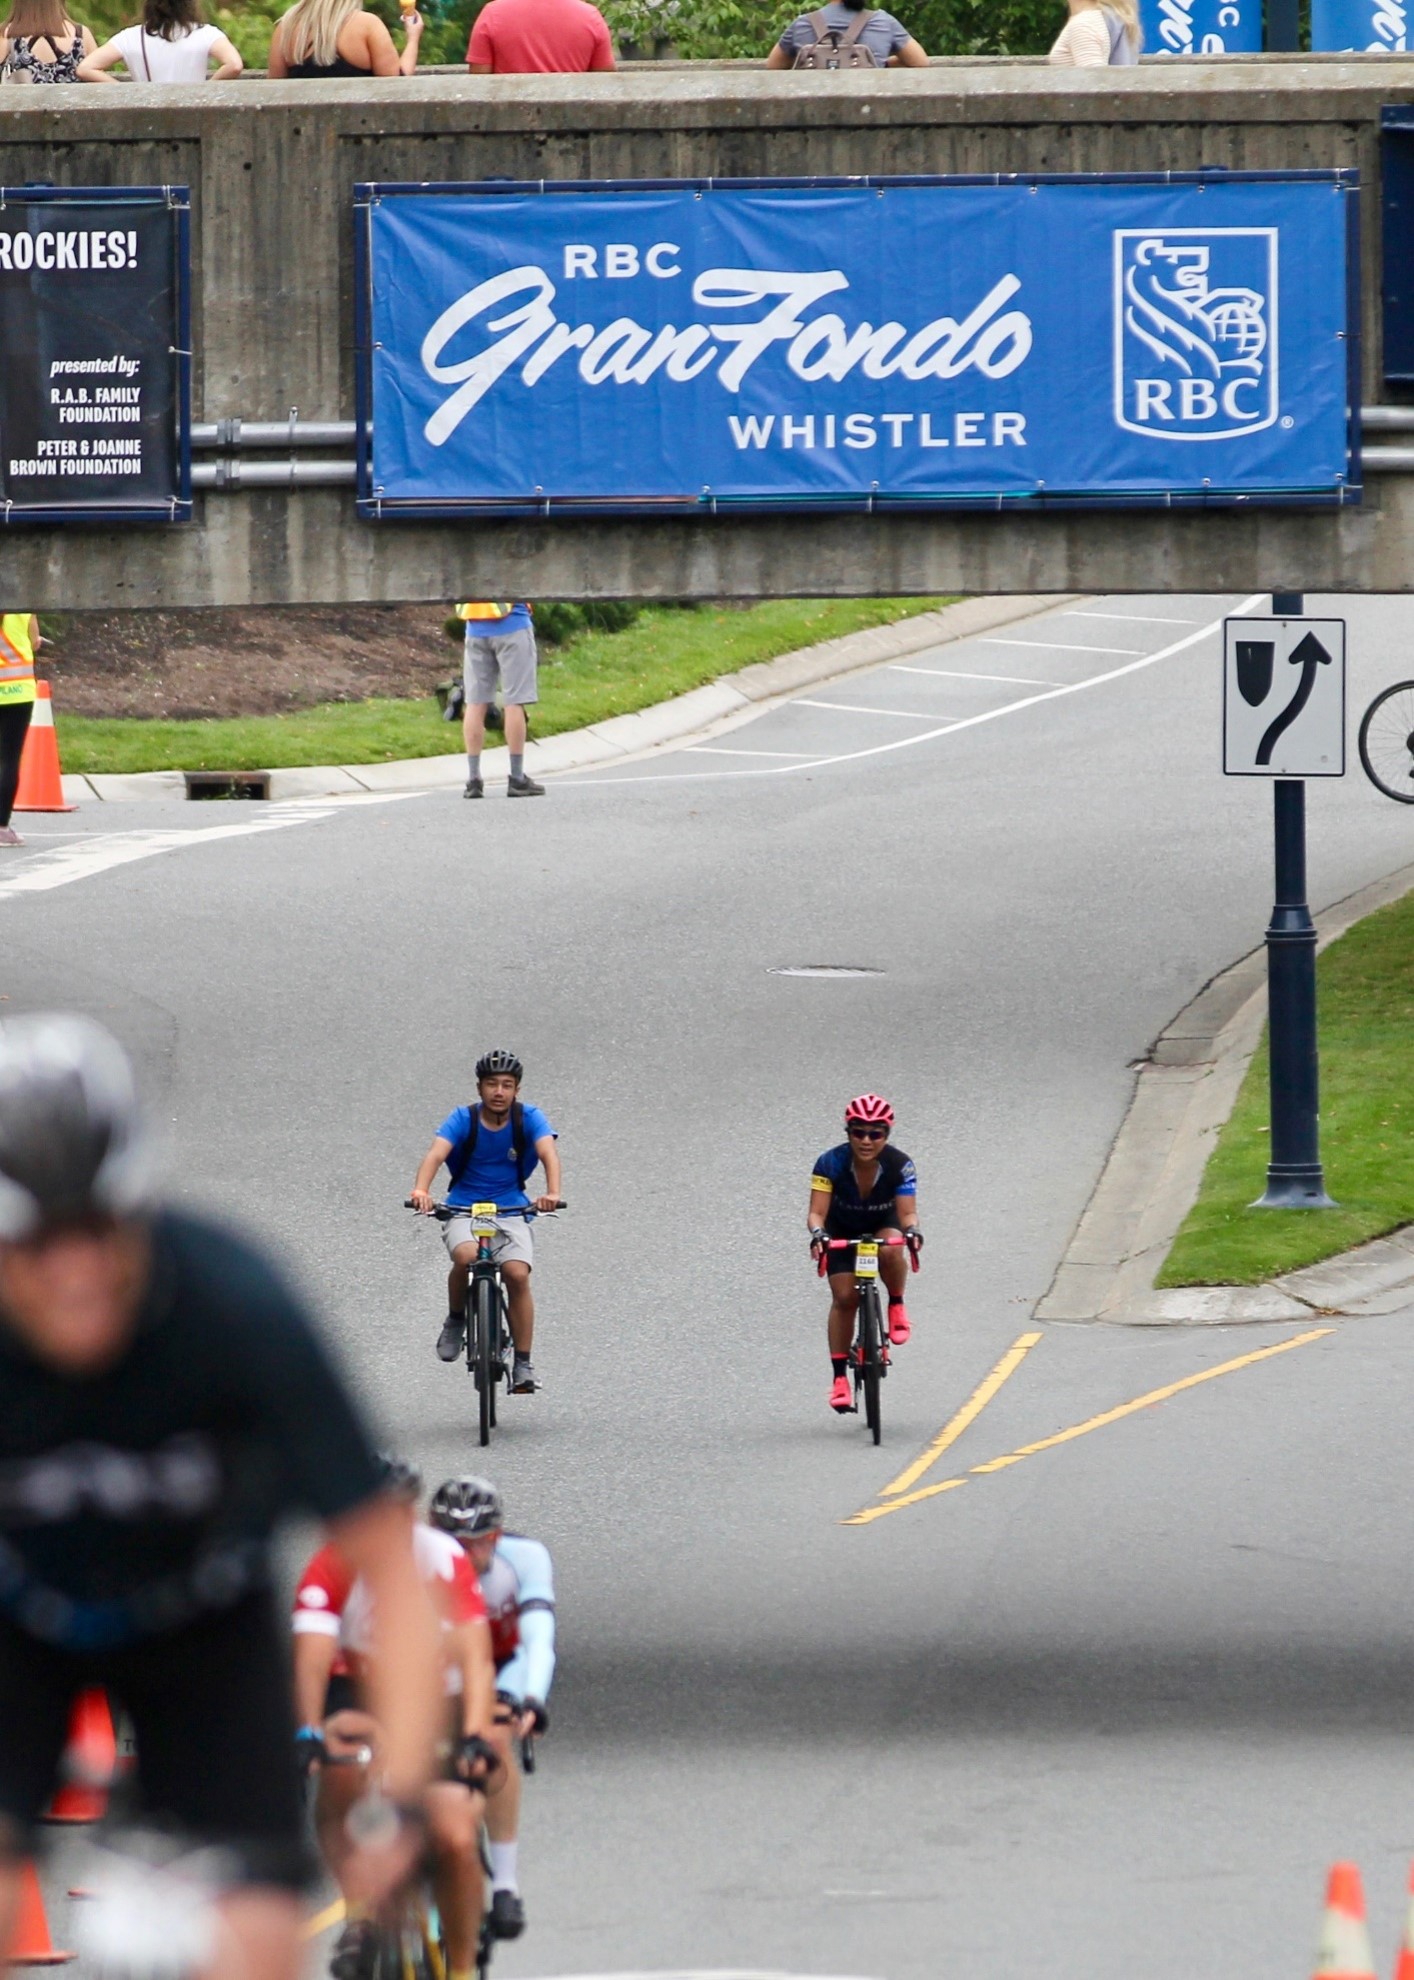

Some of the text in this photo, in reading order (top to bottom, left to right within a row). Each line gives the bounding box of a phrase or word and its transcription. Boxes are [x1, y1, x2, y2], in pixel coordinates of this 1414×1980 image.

[0, 231, 137, 270] ROCKIES!
[563, 243, 682, 279] RBC
[50, 355, 141, 378] presented by:
[51, 387, 141, 404] R.A.B. FAMILY
[1134, 377, 1261, 420] RBC
[59, 407, 141, 423] FOUNDATION
[728, 411, 1028, 450] WHISTLER
[37, 439, 141, 456] PETER & JOANNE
[10, 458, 141, 476] BROWN FOUNDATION
